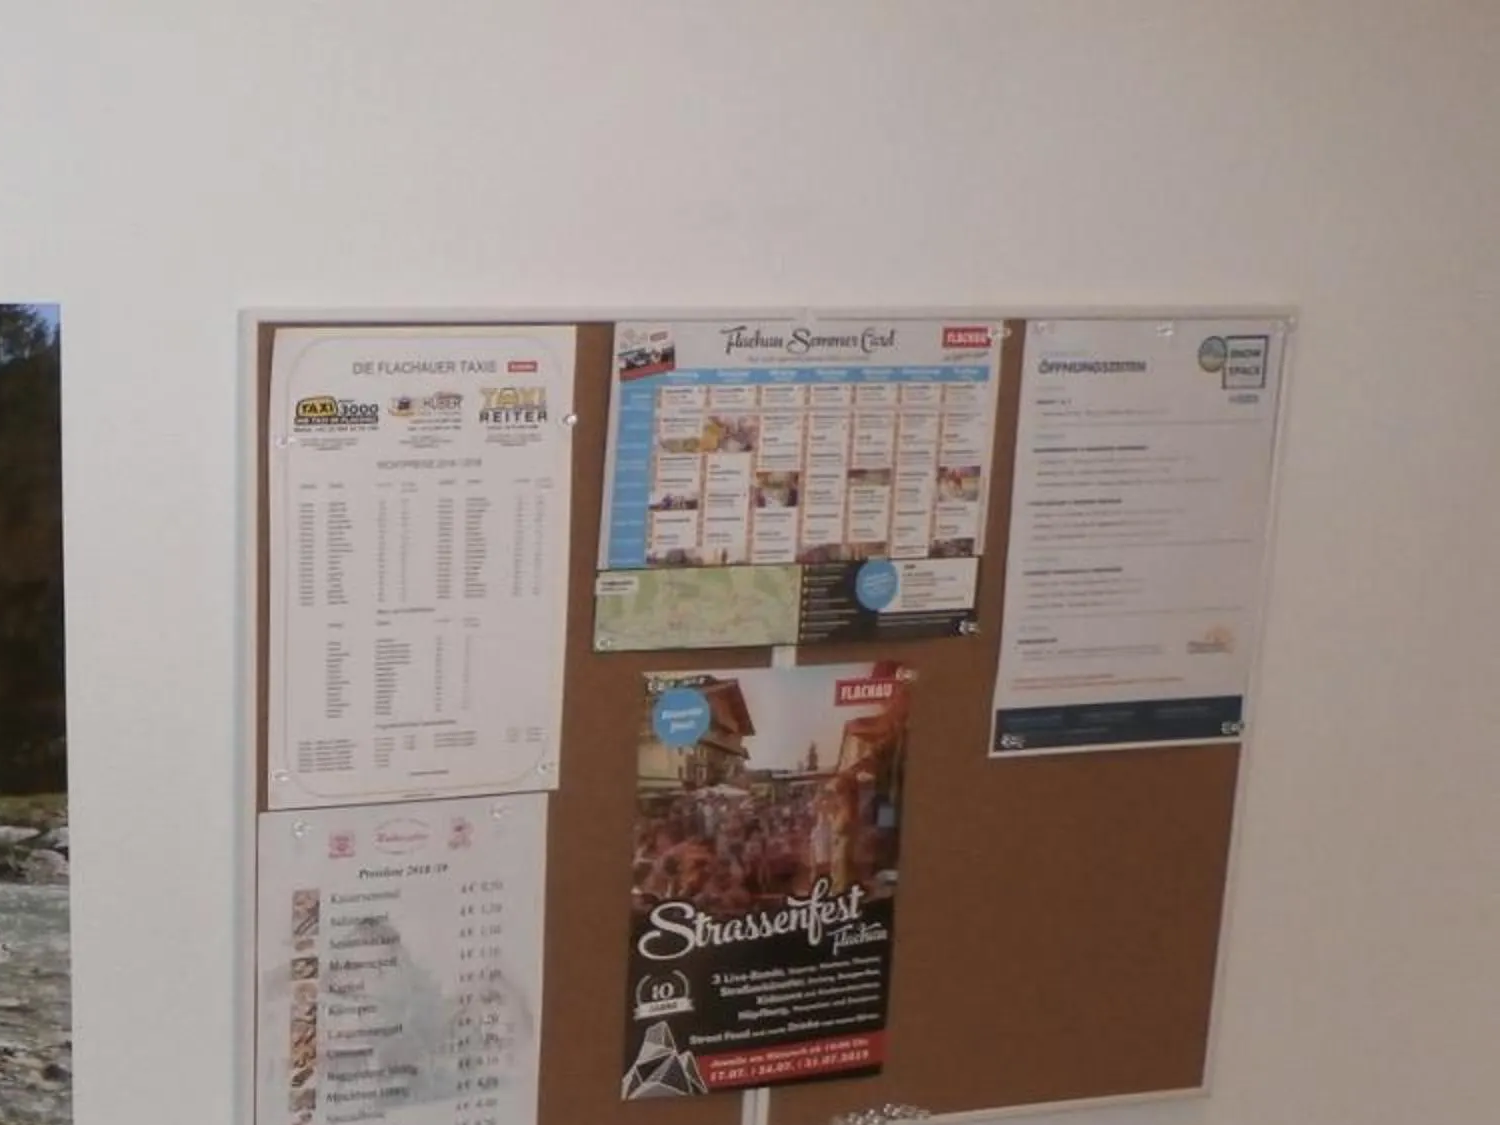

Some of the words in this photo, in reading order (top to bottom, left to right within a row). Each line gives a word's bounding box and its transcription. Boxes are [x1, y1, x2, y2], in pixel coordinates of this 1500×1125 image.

[787, 327, 858, 355] Sommer
[861, 327, 896, 354] Card
[352, 361, 375, 375] DIE
[377, 360, 456, 374] FLACHAUER
[301, 403, 333, 416] TAXI
[478, 409, 549, 424] REITER
[840, 683, 893, 700] FLACHAU
[637, 877, 865, 960] Strassenfest
[651, 983, 675, 1001] 10
